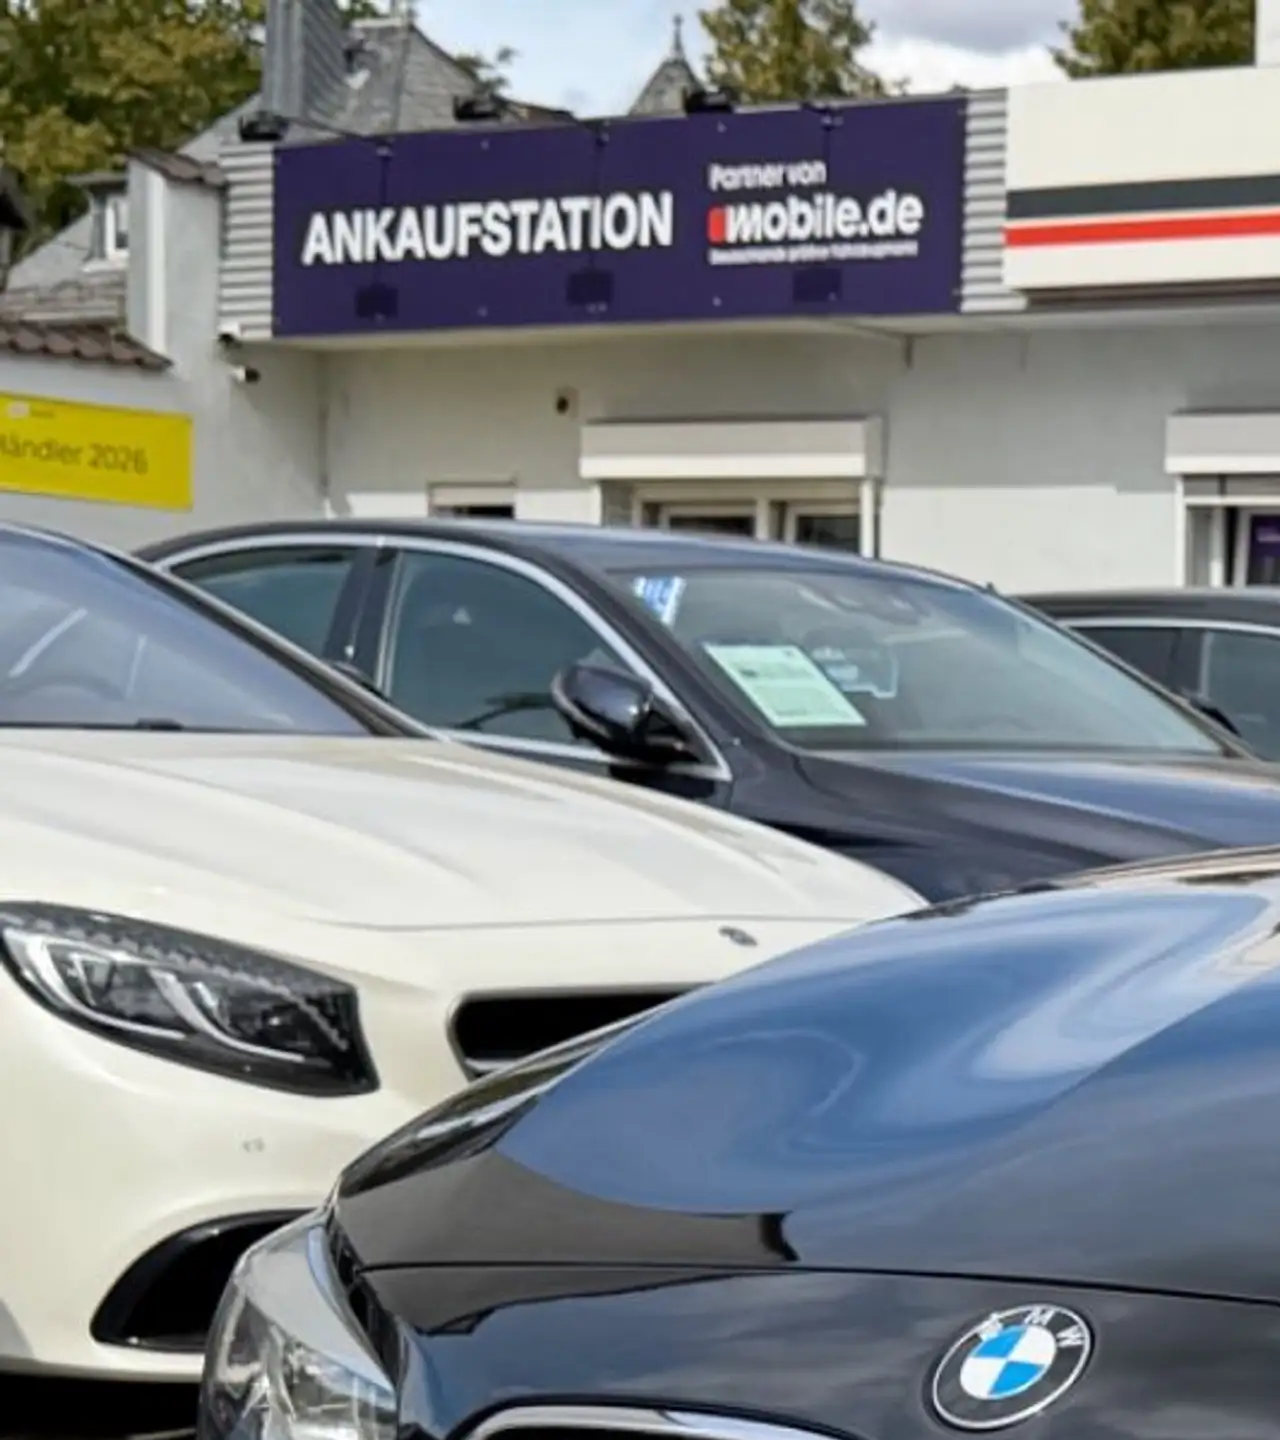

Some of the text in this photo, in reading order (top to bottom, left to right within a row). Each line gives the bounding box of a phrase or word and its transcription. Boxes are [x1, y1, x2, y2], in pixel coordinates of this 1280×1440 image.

[787, 160, 827, 185] von
[301, 191, 674, 267] ANKAUFSTATION
[725, 188, 924, 243] mobile.de
